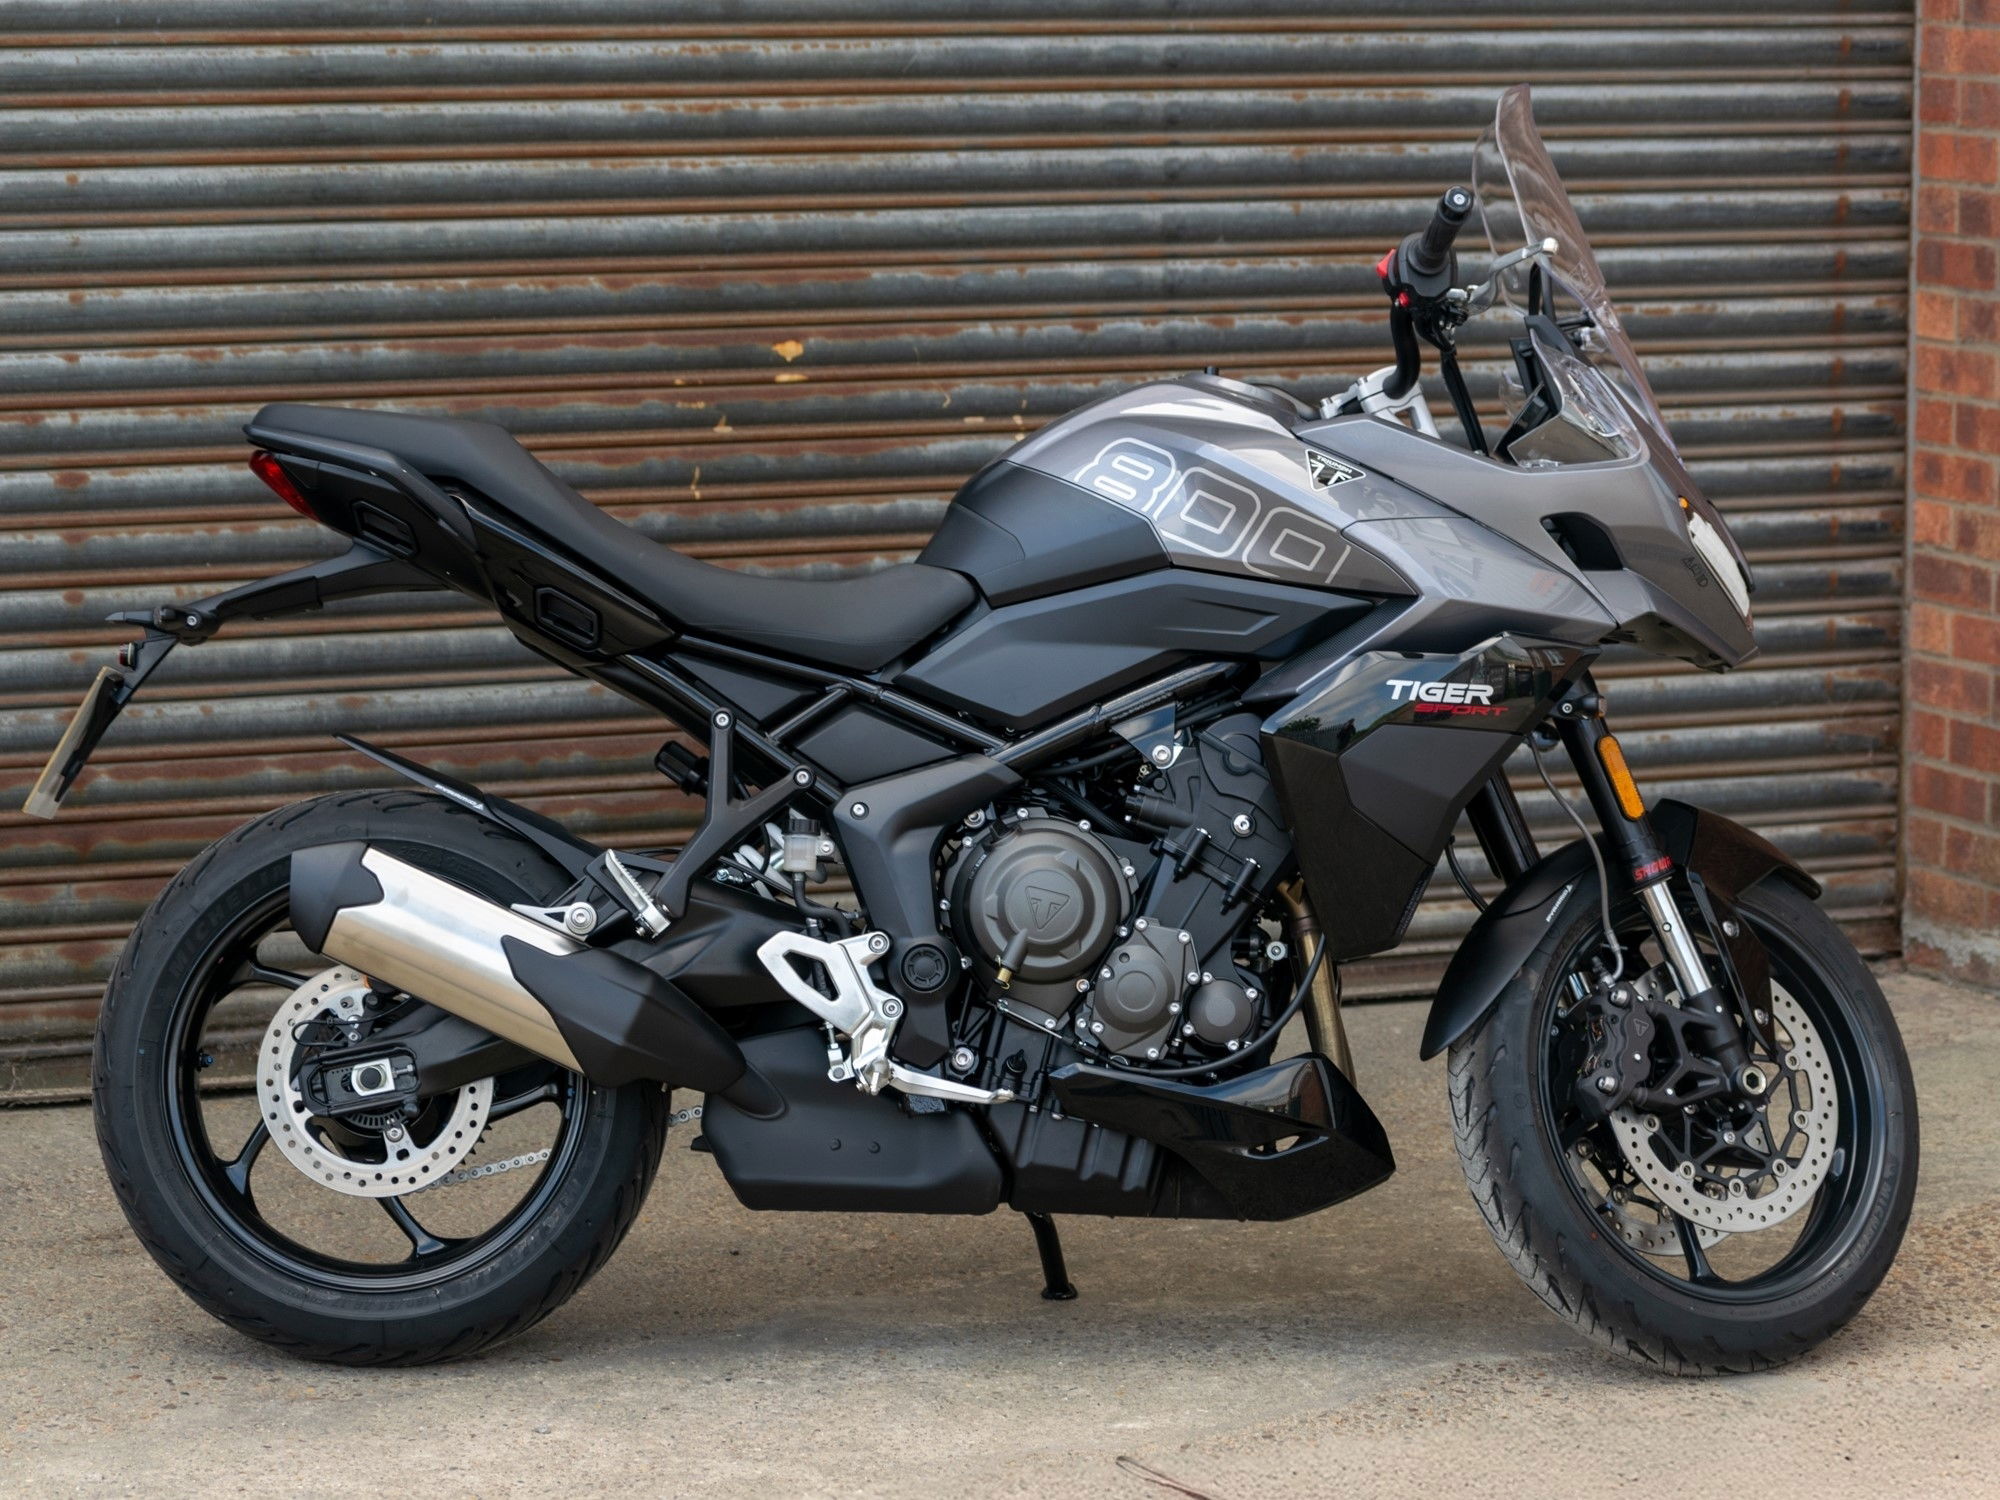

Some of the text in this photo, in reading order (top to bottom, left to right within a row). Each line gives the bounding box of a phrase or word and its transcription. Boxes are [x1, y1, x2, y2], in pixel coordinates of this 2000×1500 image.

[1316, 454, 1353, 474] TRIUMPH
[1074, 437, 1351, 584] 800
[1386, 679, 1494, 705] TIGER
[1414, 703, 1509, 716] SPORT
